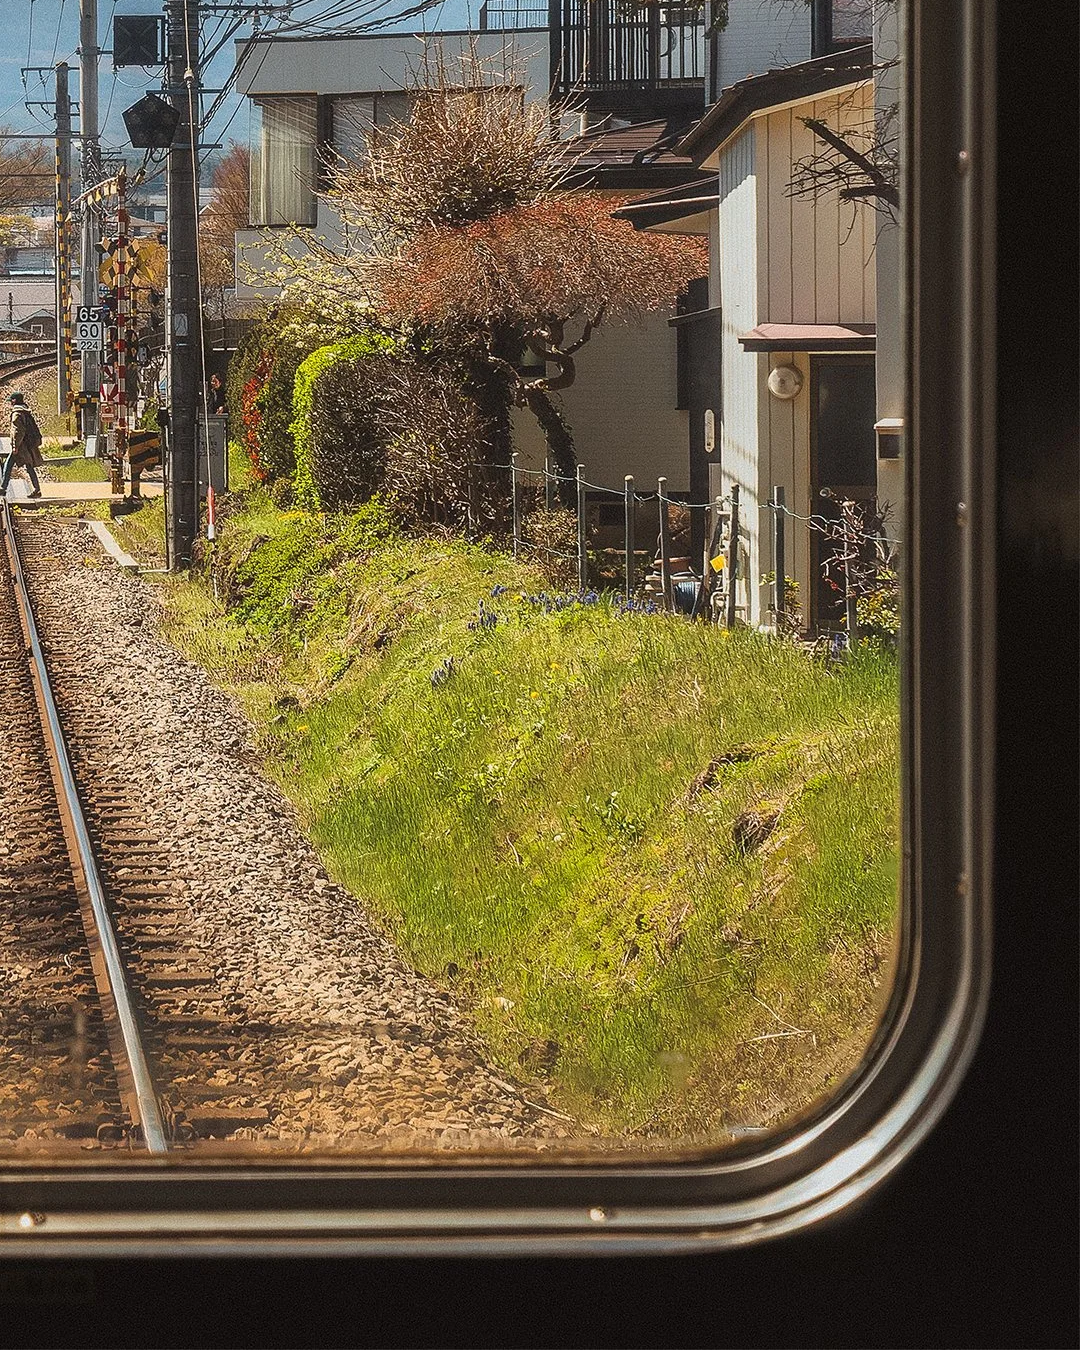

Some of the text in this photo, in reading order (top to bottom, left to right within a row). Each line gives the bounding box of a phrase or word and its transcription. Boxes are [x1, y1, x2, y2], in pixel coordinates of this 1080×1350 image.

[80, 307, 99, 321] 65
[80, 324, 99, 338] 60
[80, 341, 98, 350] 224
